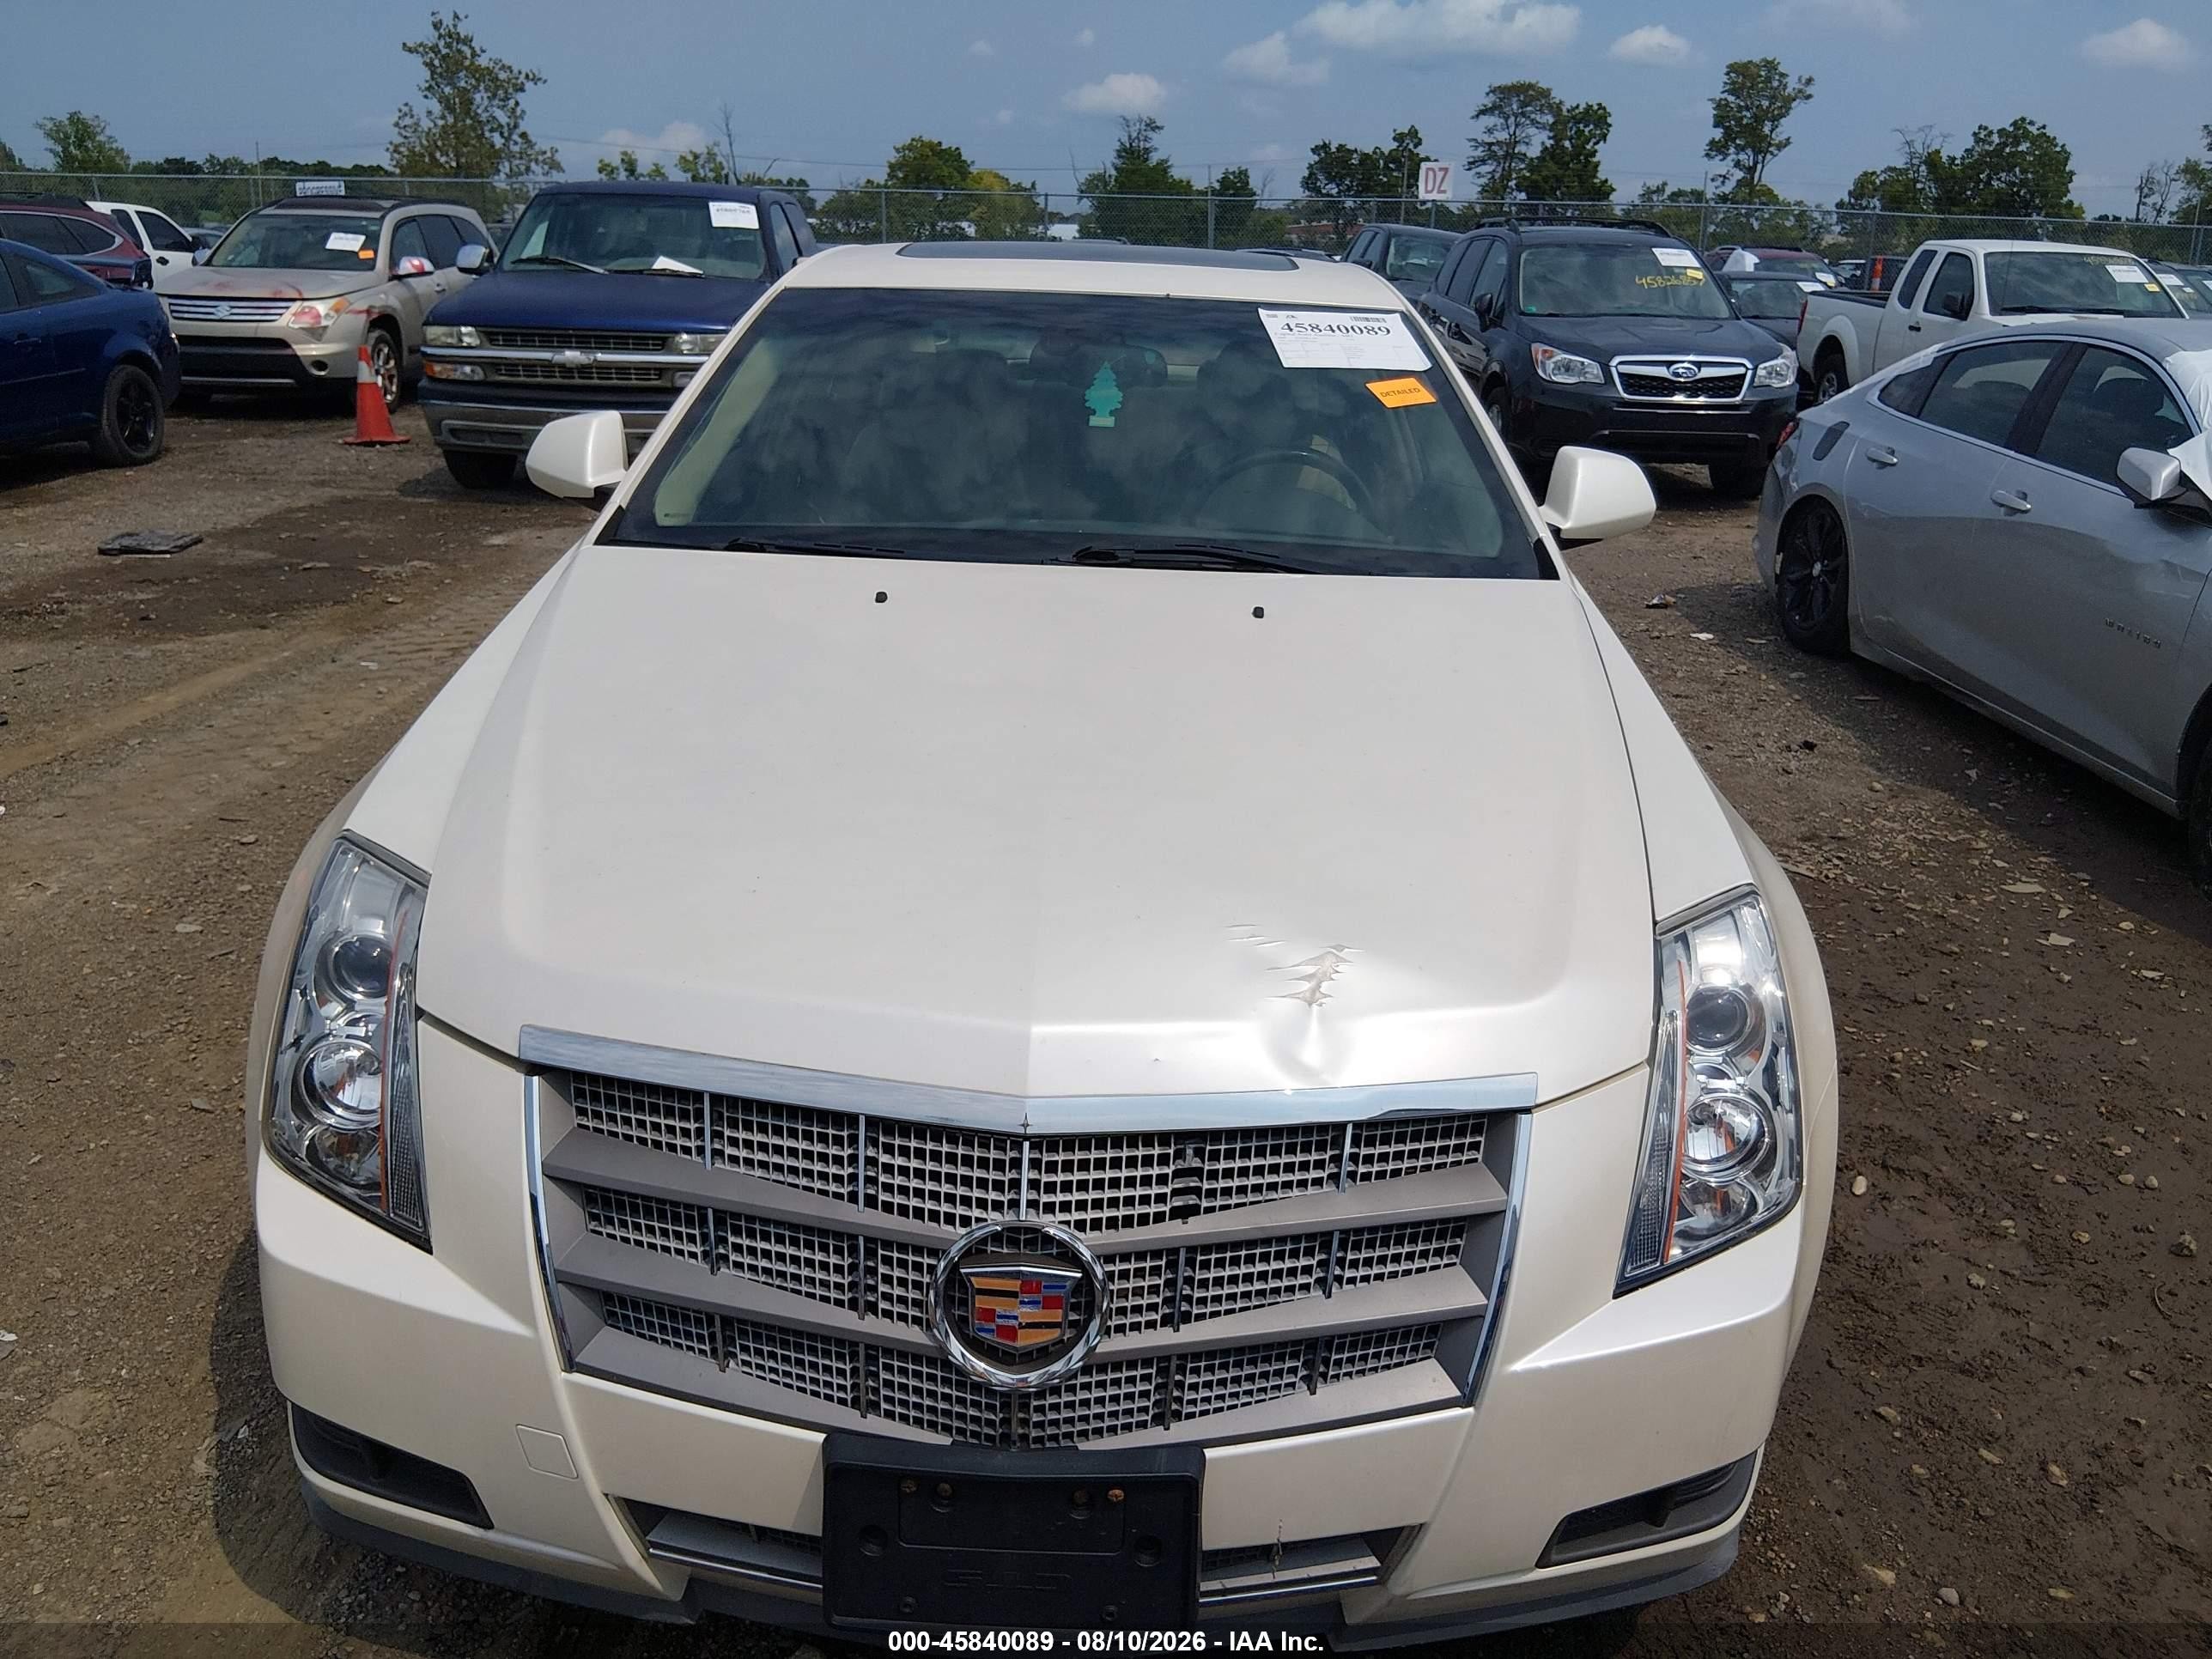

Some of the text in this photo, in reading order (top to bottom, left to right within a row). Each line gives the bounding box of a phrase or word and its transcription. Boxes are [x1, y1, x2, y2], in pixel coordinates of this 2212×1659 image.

[1425, 167, 1449, 194] DZ
[1280, 322, 1391, 337] 45840089
[1380, 387, 1421, 398] DETAILED
